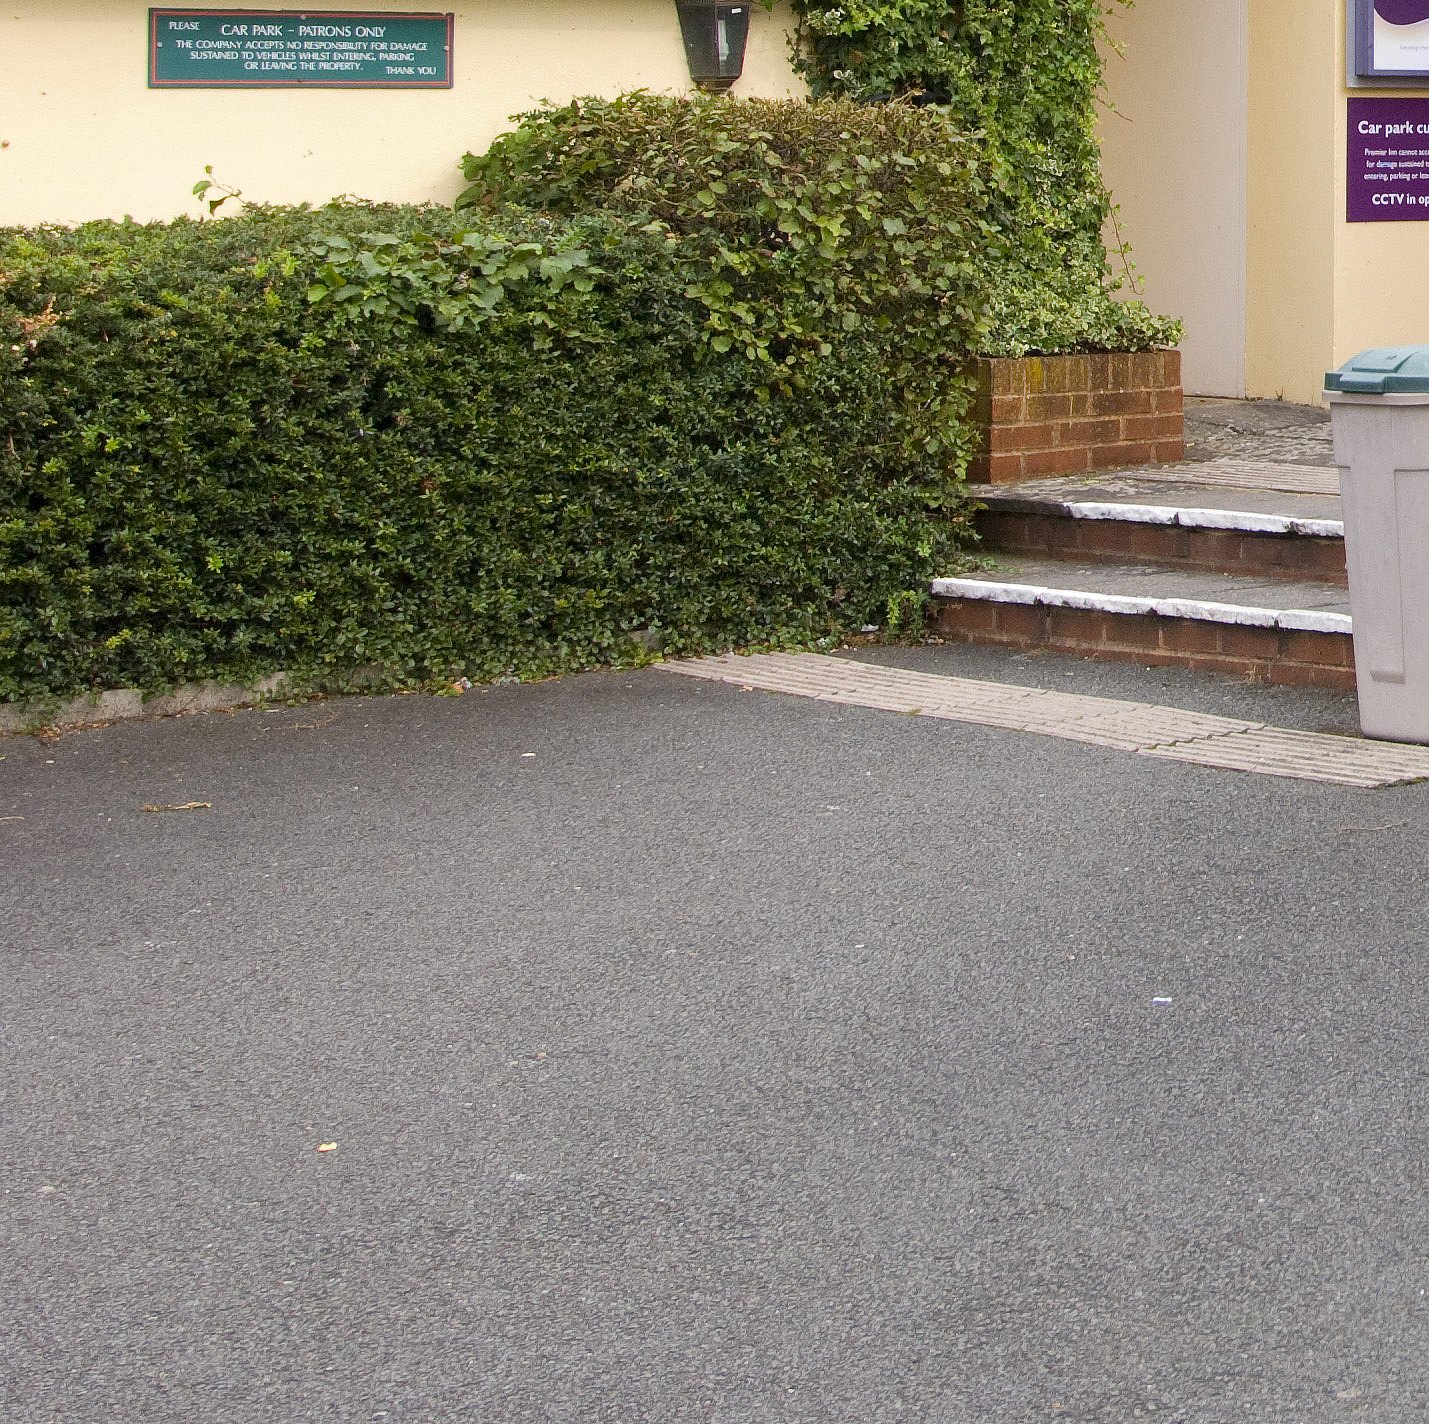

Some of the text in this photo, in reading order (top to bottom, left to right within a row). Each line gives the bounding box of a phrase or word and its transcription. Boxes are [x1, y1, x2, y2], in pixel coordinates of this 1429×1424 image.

[169, 21, 201, 30] PLEASE
[221, 24, 248, 36] CAR
[252, 24, 283, 36] PARK
[298, 25, 352, 38] PATRONS
[355, 26, 386, 38] ONLY
[176, 40, 428, 51] THE COMPANY ACCEPTS NO RESPONSIBILITY FOR DAMAGE
[190, 50, 238, 60] SUSTAINED
[241, 51, 254, 60] TO
[256, 52, 296, 60] VEHICLES
[299, 52, 330, 60] WHILST
[379, 53, 414, 61] PARKING
[244, 62, 258, 70] OR
[262, 62, 297, 70] LEAVING
[300, 62, 316, 70] THE
[386, 66, 415, 75] THANK
[1358, 120, 1382, 135] Car
[1385, 121, 1414, 138] park
[1364, 148, 1388, 156] Premier
[1388, 148, 1398, 156] Inn
[1366, 160, 1375, 168] for
[1376, 160, 1398, 170] damage
[1390, 172, 1410, 182] parking
[1372, 193, 1404, 206] CCTV
[1406, 193, 1416, 205] in
